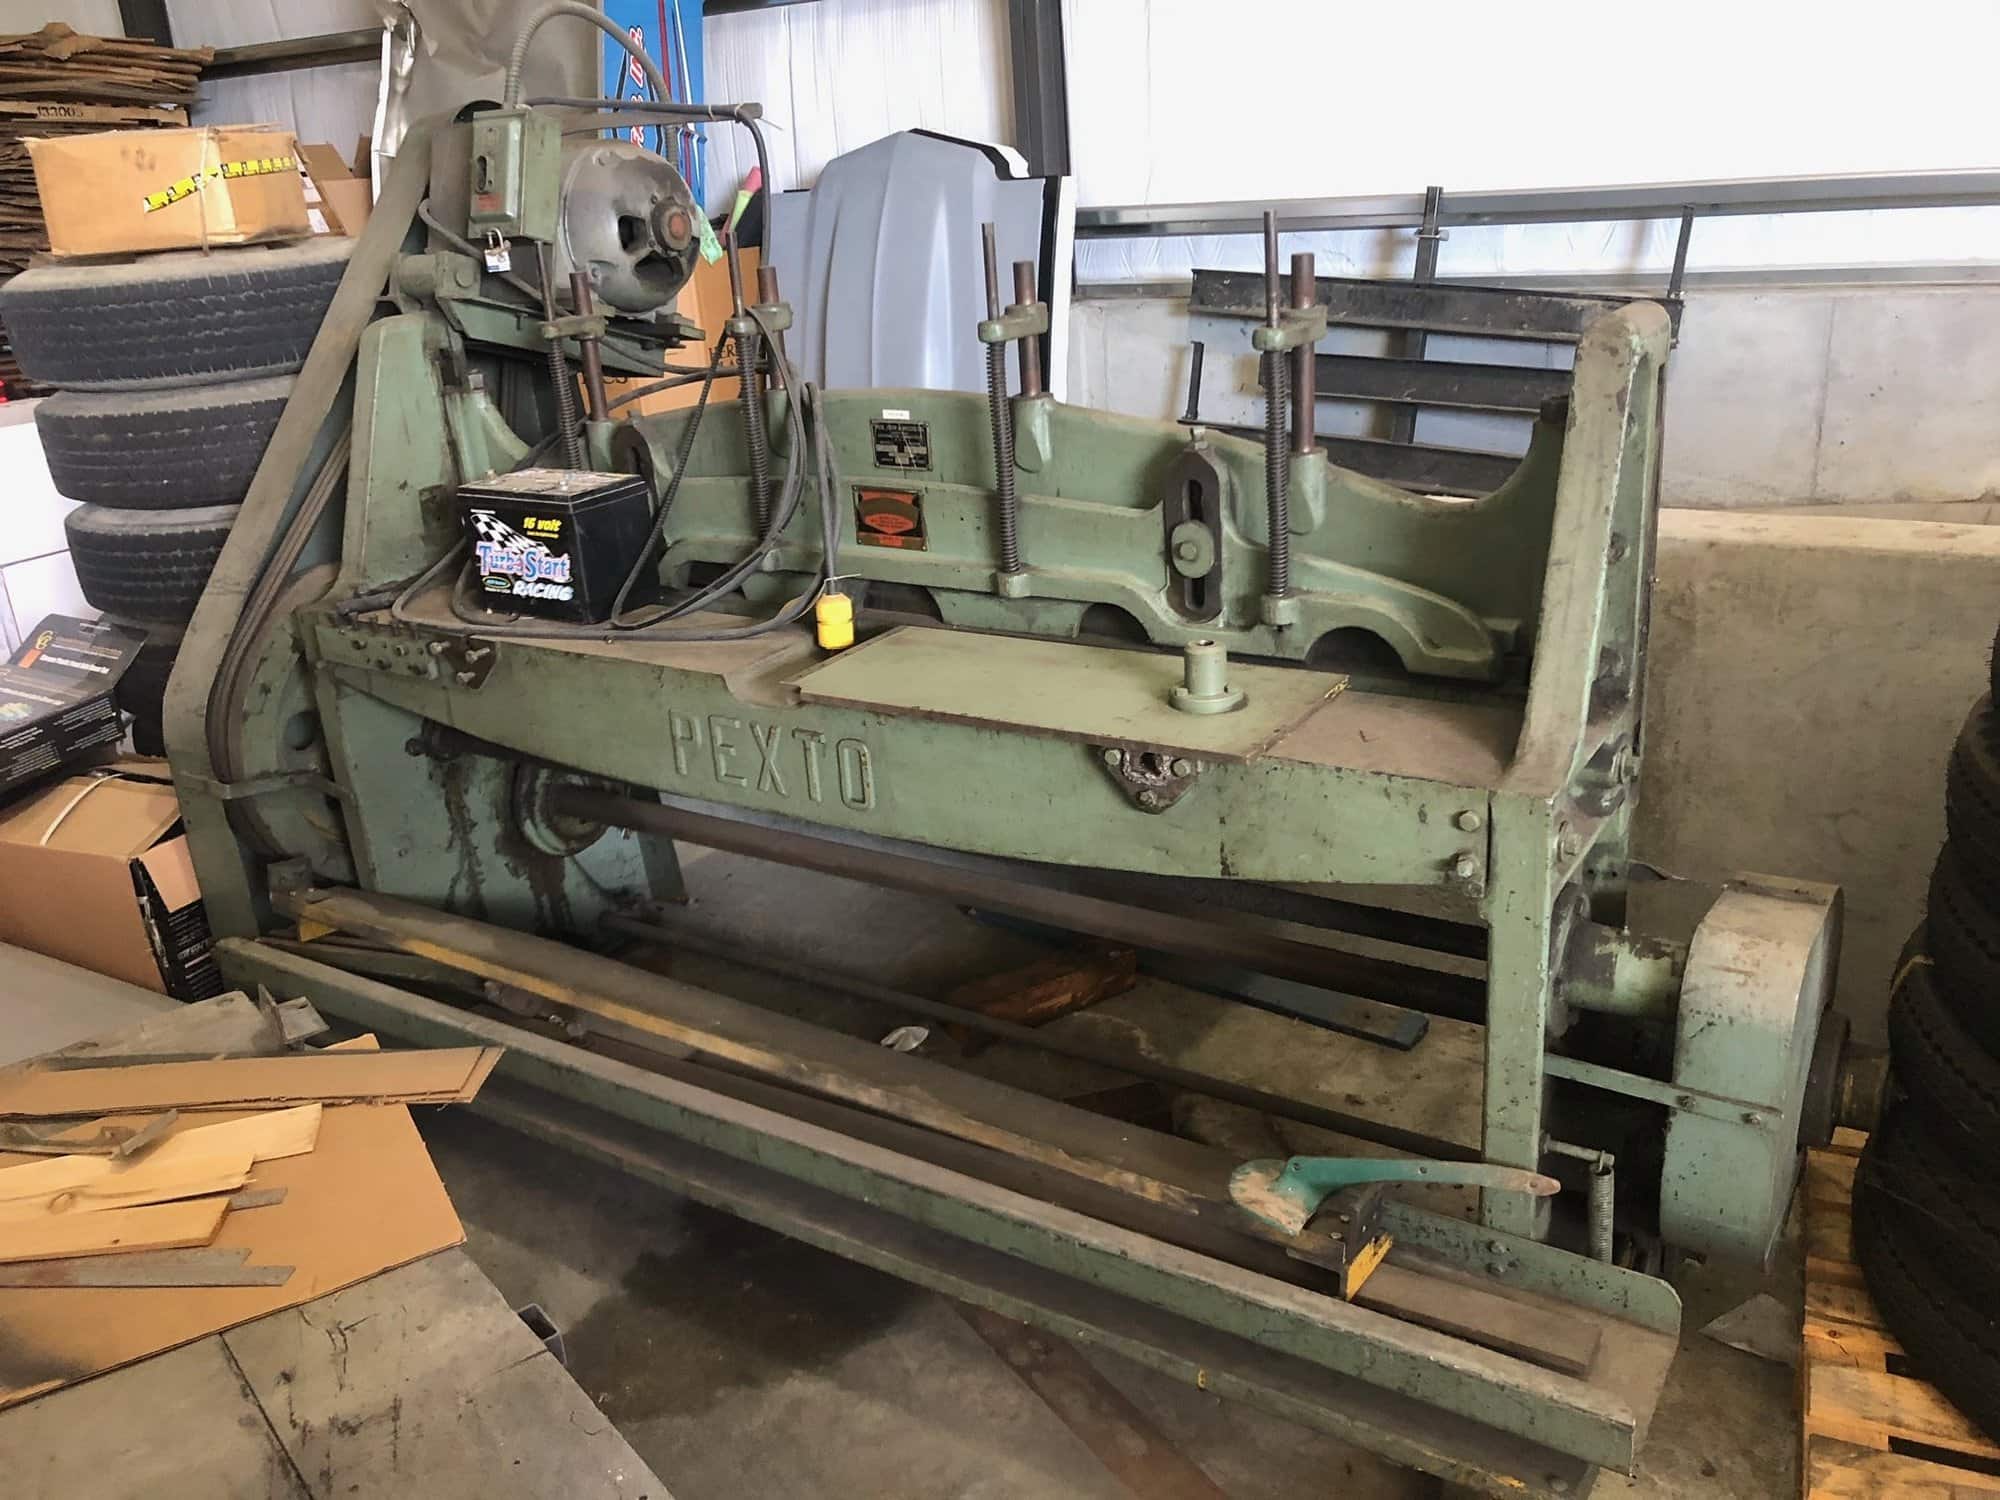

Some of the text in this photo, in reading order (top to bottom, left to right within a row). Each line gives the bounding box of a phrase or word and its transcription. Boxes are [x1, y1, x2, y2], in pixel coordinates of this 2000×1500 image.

[523, 517, 562, 532] 16 volt
[512, 581, 574, 601] RACING
[668, 708, 876, 810] PEXTO
